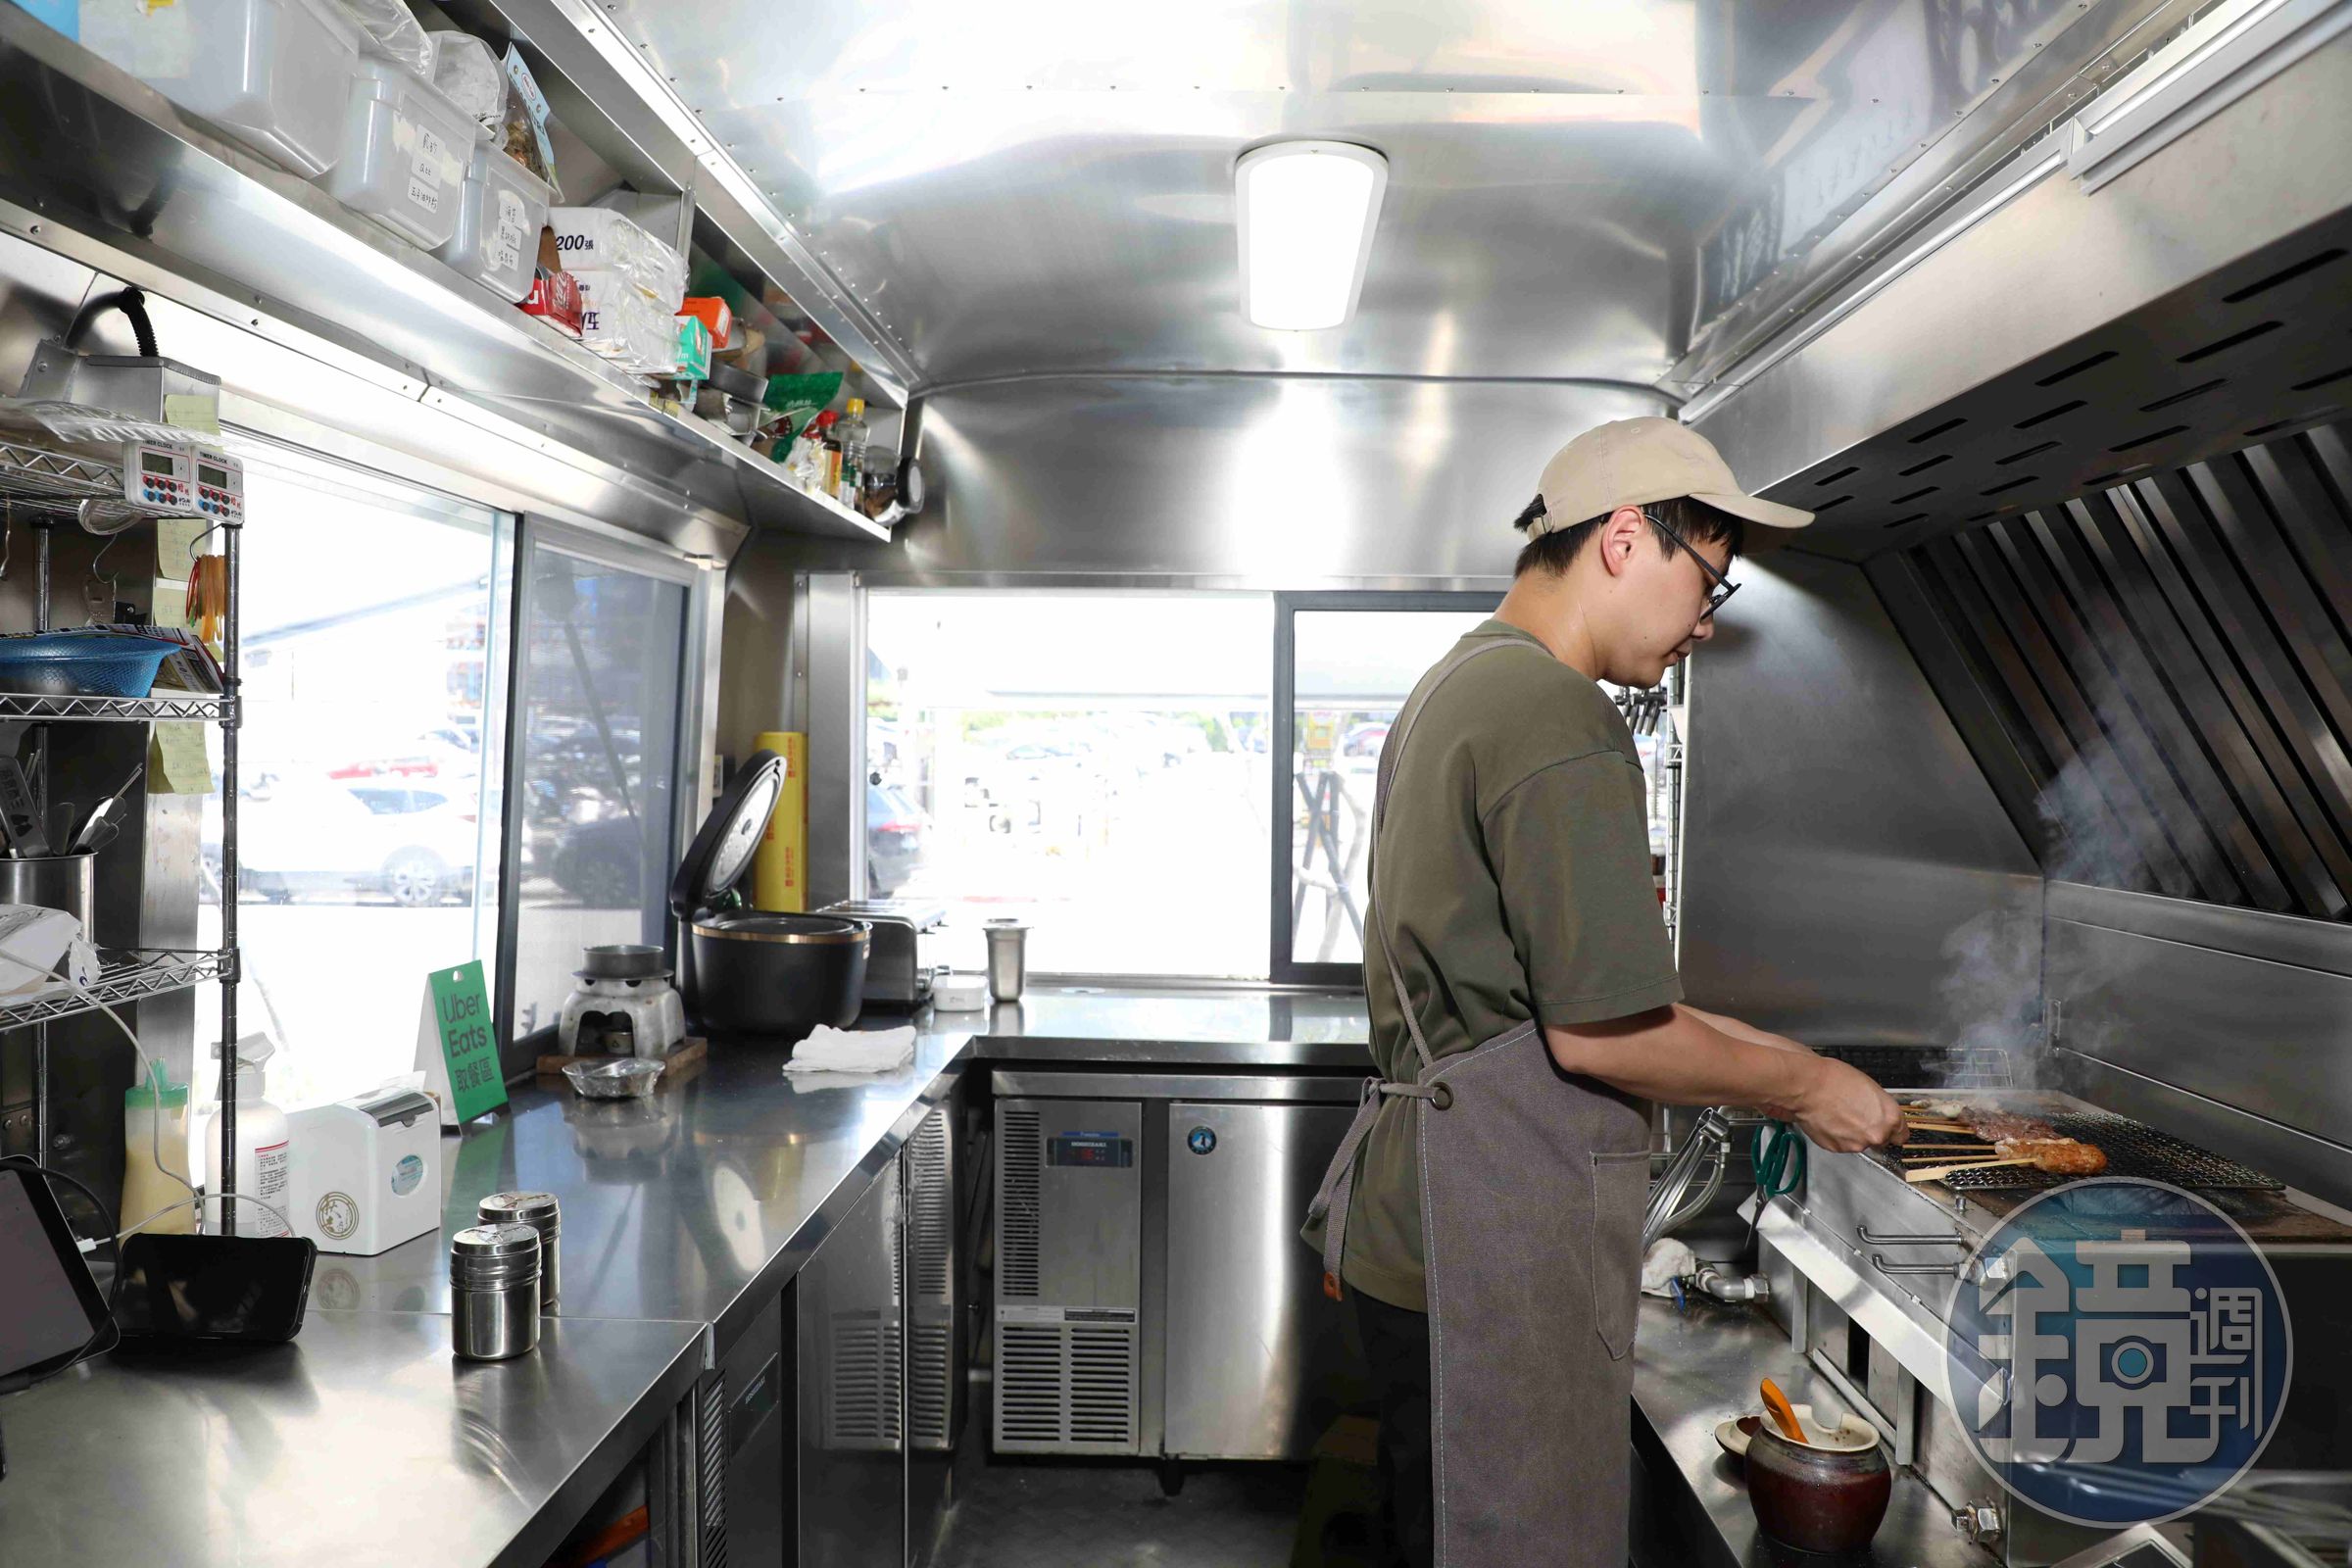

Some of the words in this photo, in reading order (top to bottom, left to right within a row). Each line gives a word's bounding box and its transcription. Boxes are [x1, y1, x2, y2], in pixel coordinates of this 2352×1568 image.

[556, 234, 594, 251] 200張
[442, 993, 481, 1024] Uber
[447, 1024, 488, 1057] Eats
[455, 1057, 495, 1093] 取餐區
